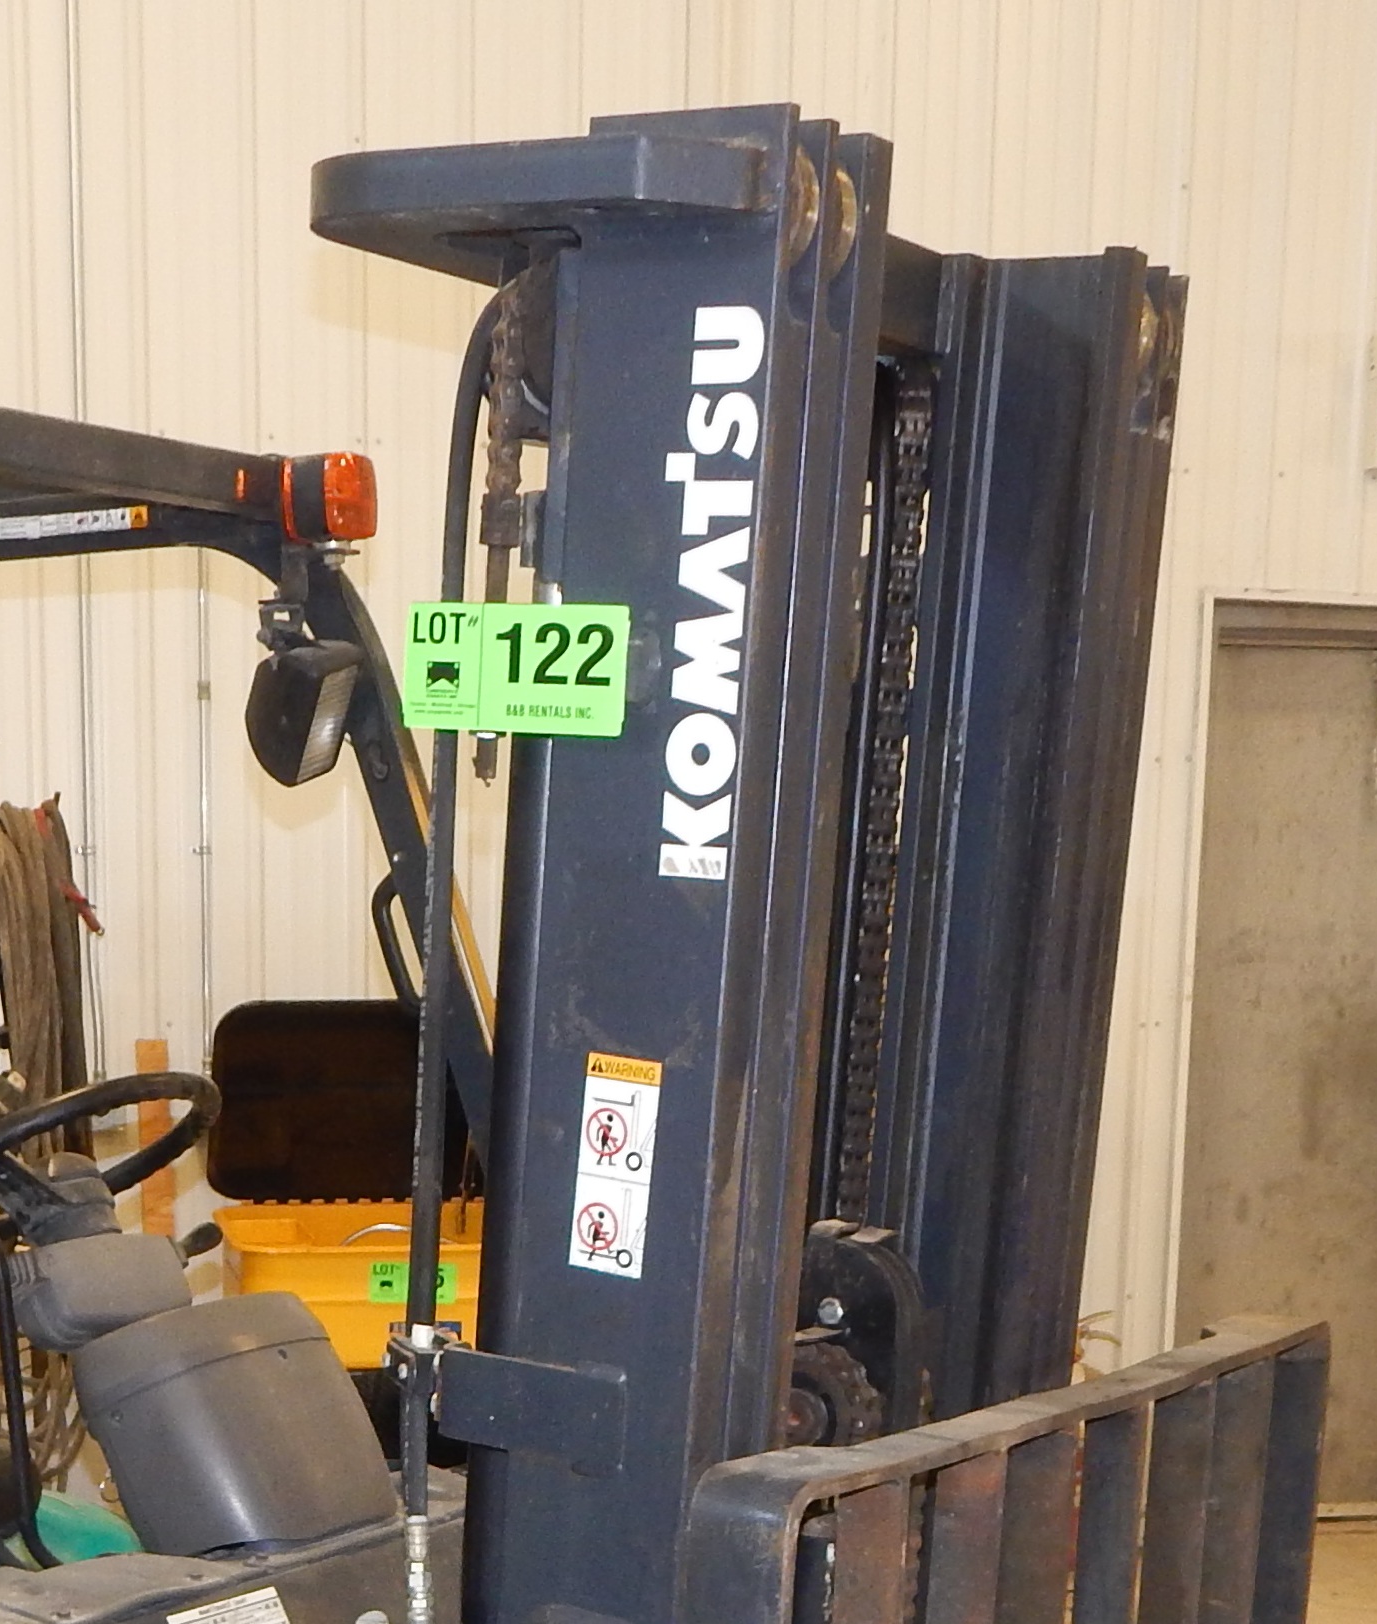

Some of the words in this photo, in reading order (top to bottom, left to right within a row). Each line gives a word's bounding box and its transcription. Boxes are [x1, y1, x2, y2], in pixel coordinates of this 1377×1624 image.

[657, 305, 765, 880] KOMATSU
[495, 621, 614, 687] 122
[505, 703, 525, 717] B&B
[528, 704, 572, 719] RENTALS
[605, 1060, 657, 1081] WARNING
